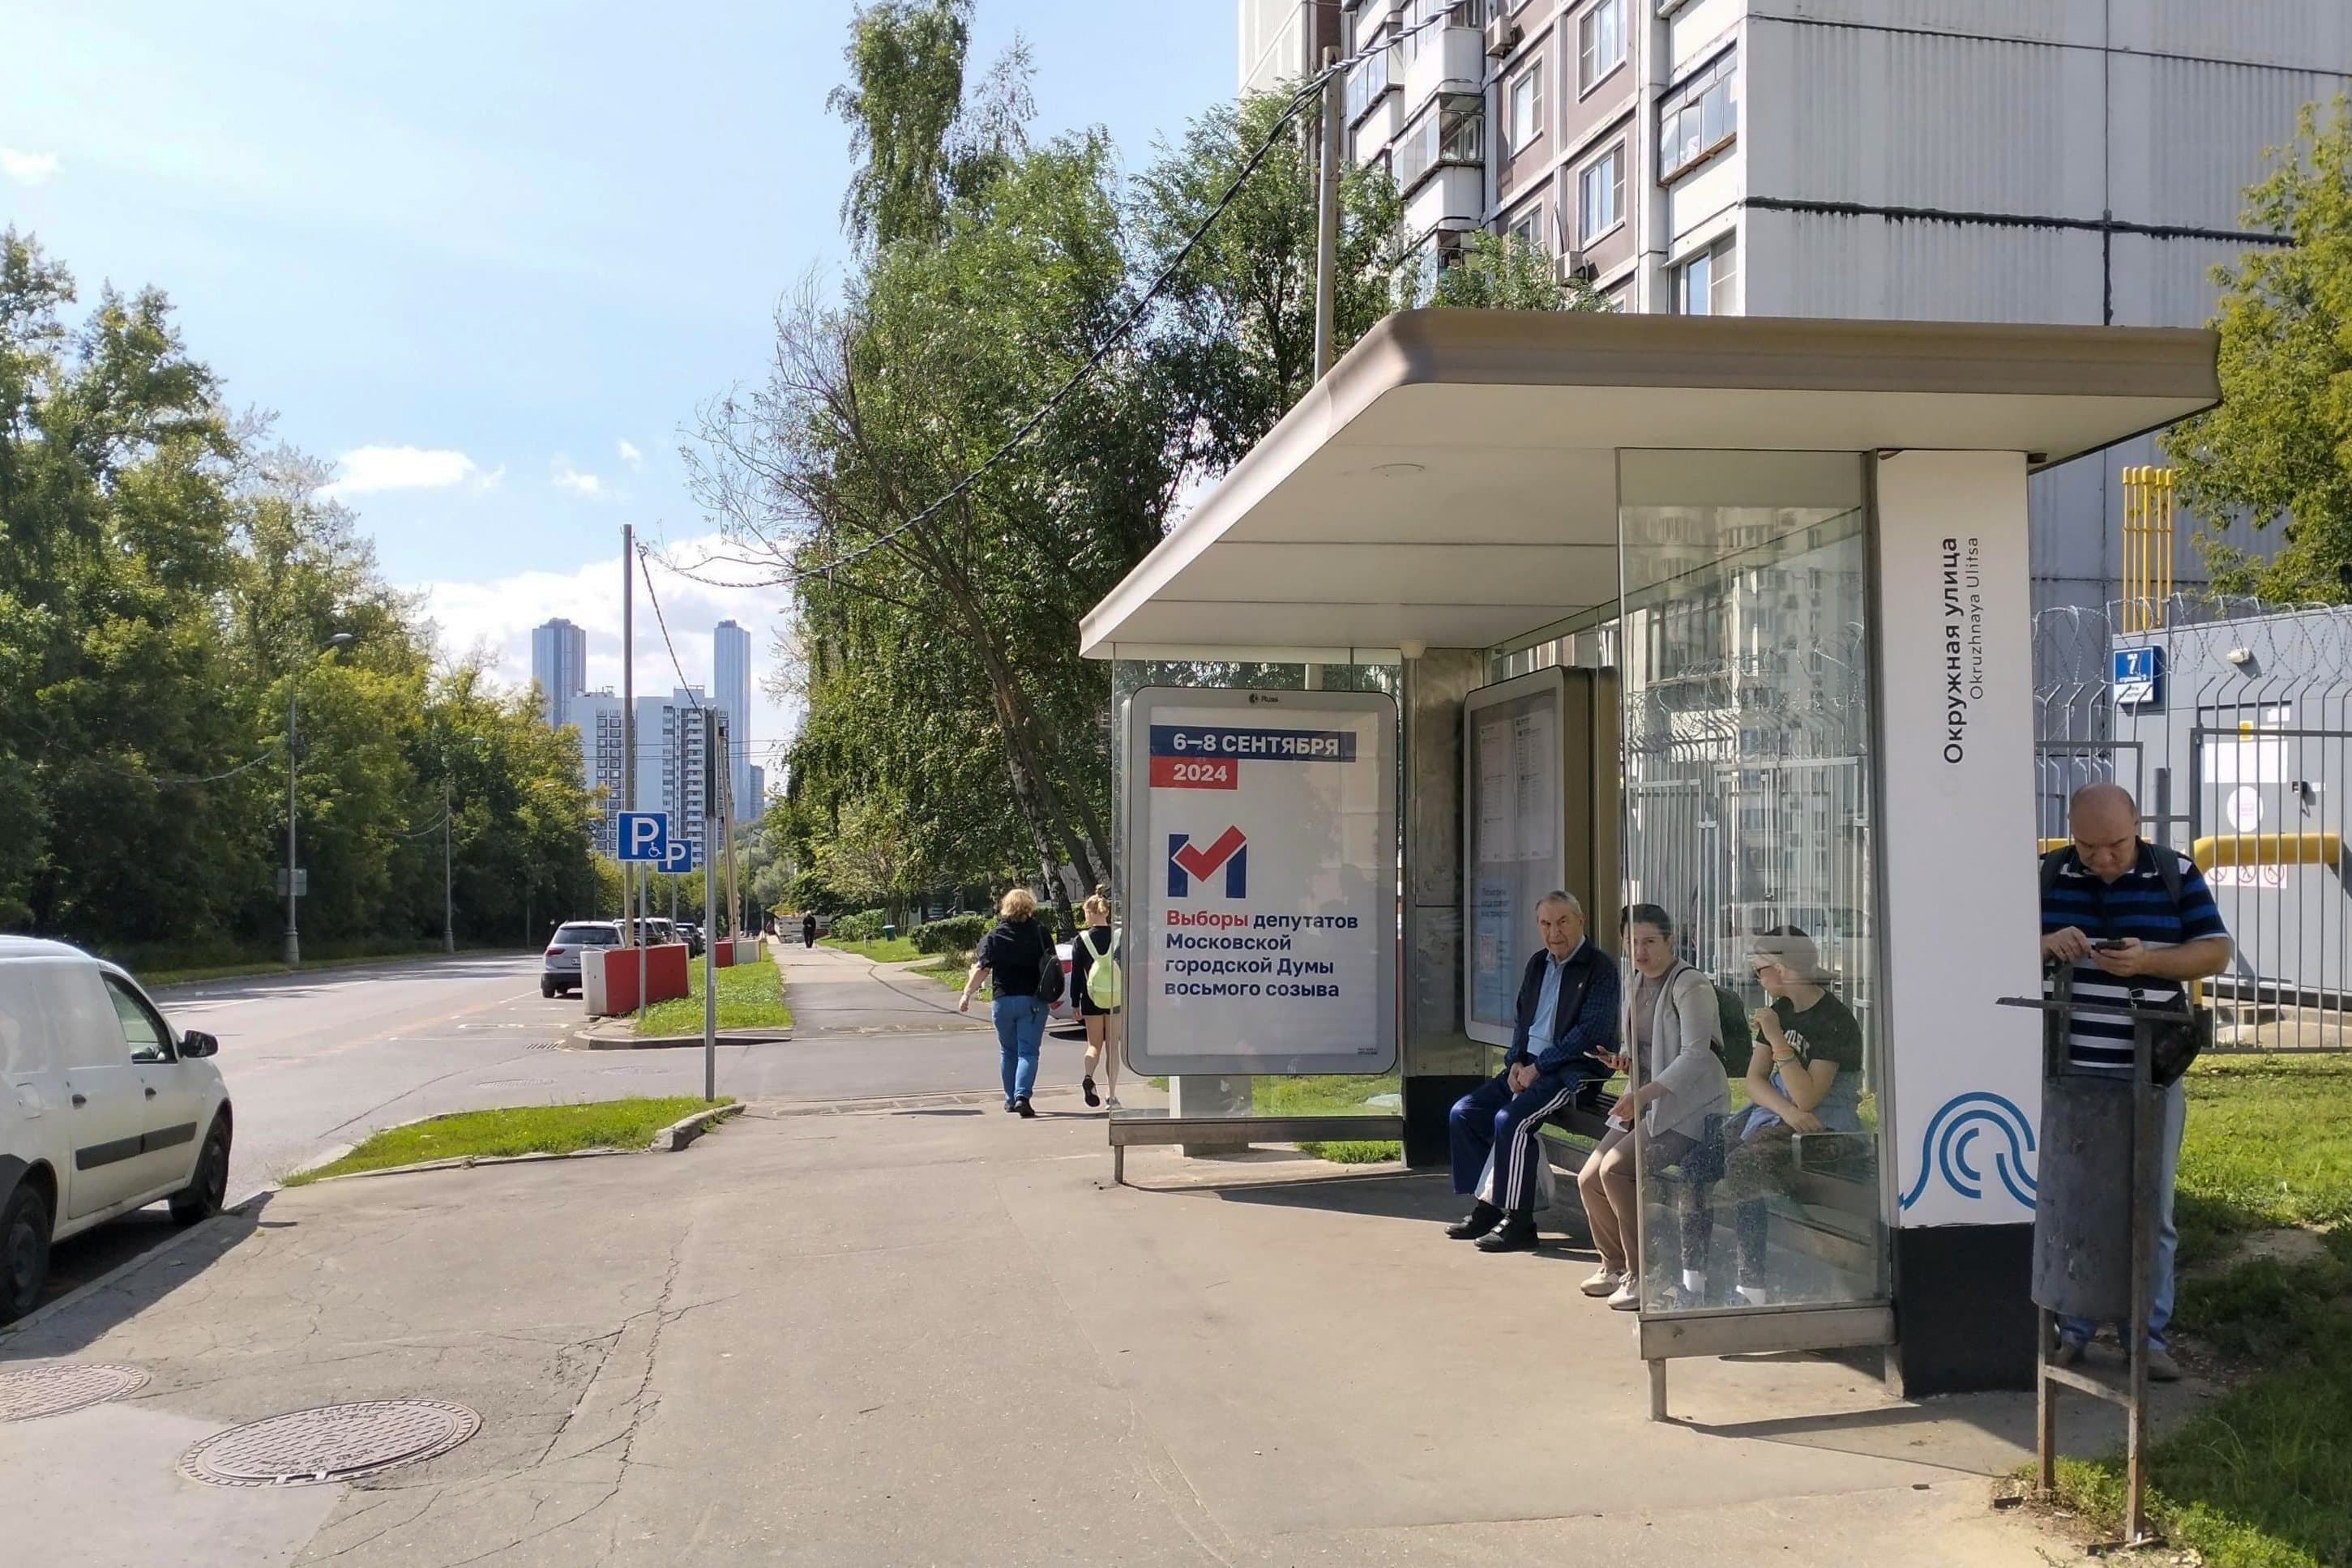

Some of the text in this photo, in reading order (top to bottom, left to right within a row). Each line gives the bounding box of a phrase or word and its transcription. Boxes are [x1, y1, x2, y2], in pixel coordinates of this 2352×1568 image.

[1965, 537, 1984, 699] Okruzhnaya Ulitsa
[1943, 537, 1968, 764] Окружная улица
[2127, 653, 2138, 675] 7
[1221, 734, 1339, 756] СЕНТЯБРЯ
[1173, 763, 1228, 782] 2024
[631, 817, 660, 856] P
[1165, 909, 1358, 932] Выборы депутатов
[1165, 933, 1292, 951] Московской
[1165, 956, 1334, 977] городской Думы
[1164, 982, 1340, 998] восьмого созыва
